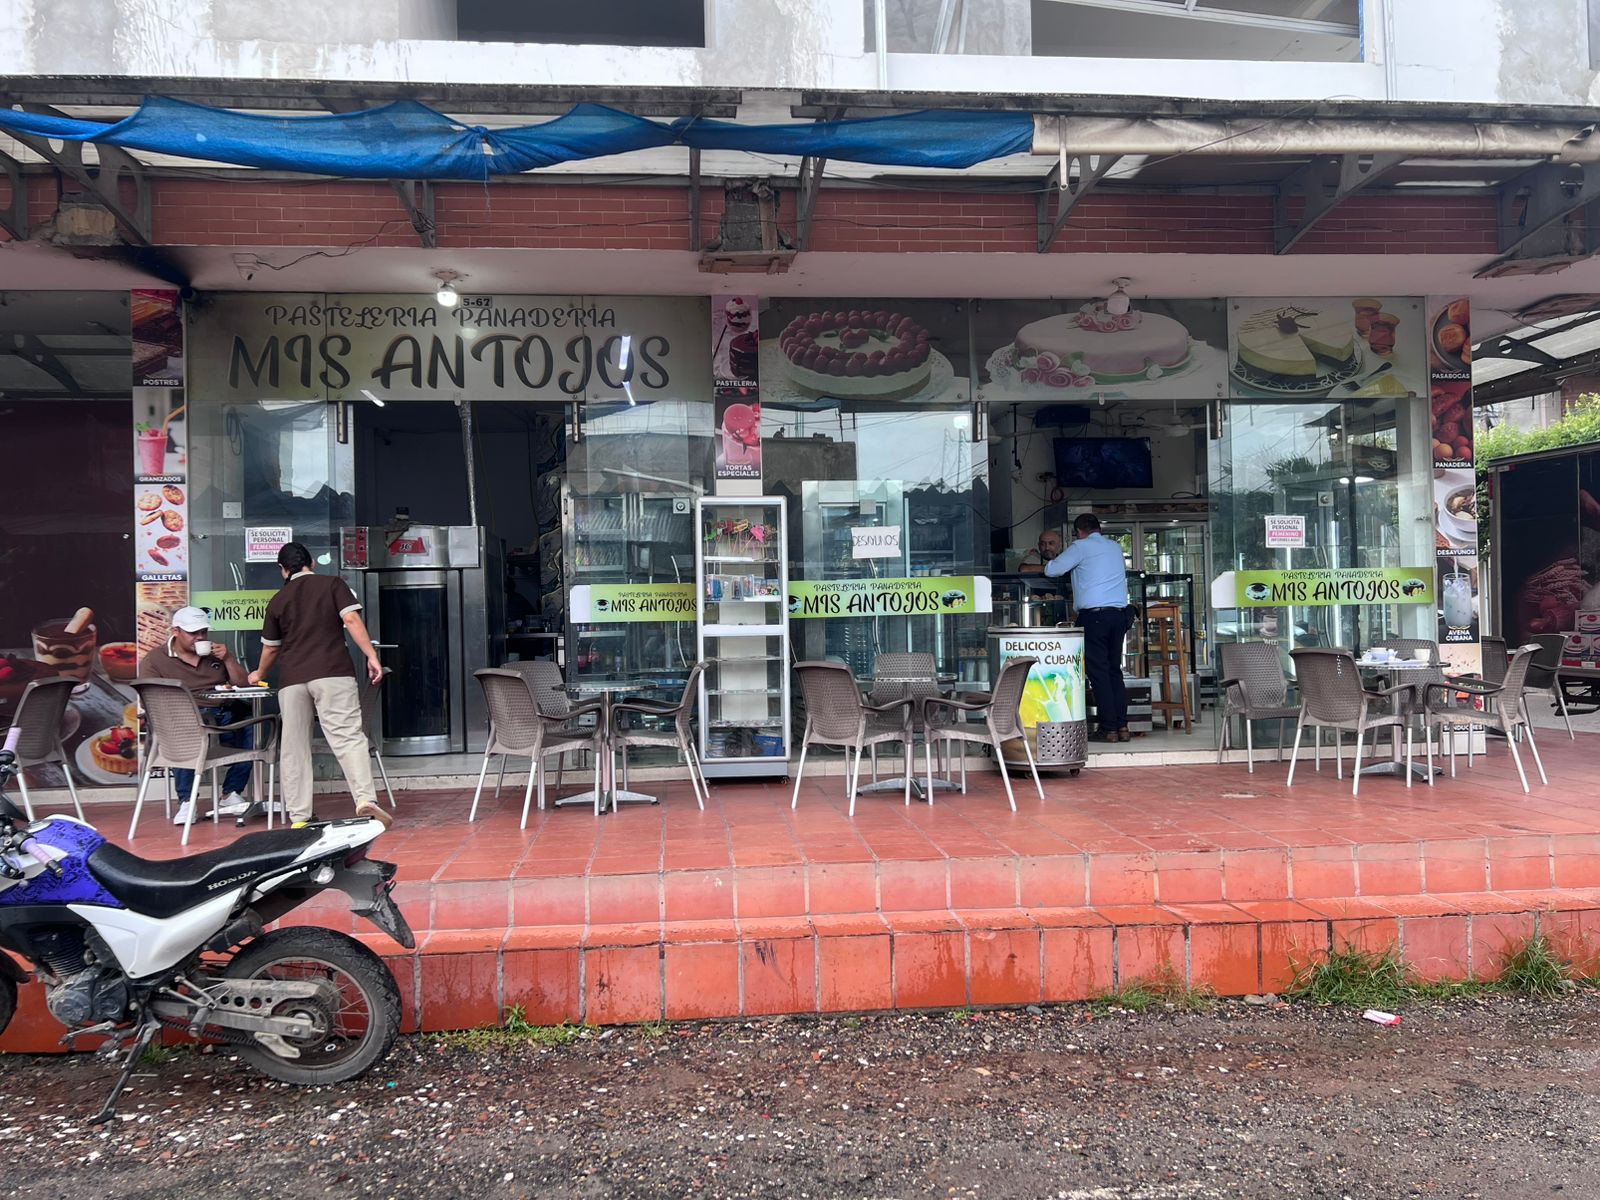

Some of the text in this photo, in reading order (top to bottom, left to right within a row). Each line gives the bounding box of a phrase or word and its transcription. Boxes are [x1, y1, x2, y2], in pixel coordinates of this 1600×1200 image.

[264, 305, 616, 329] PASTELERIA PANADERIA
[228, 333, 670, 394] MIS ANTOJOS
[1281, 570, 1384, 581] PASTELERIA PANADERIA
[813, 581, 922, 592] PASTELERIA PANADERIA
[1271, 579, 1400, 602] MIS ANTOJOS
[611, 598, 697, 614] MIS ANTOJOS
[803, 590, 940, 615] MIS ANTOJOS
[214, 605, 241, 621] MIS
[1005, 641, 1062, 652] DELICIOSA
[208, 871, 258, 890] HONDA
